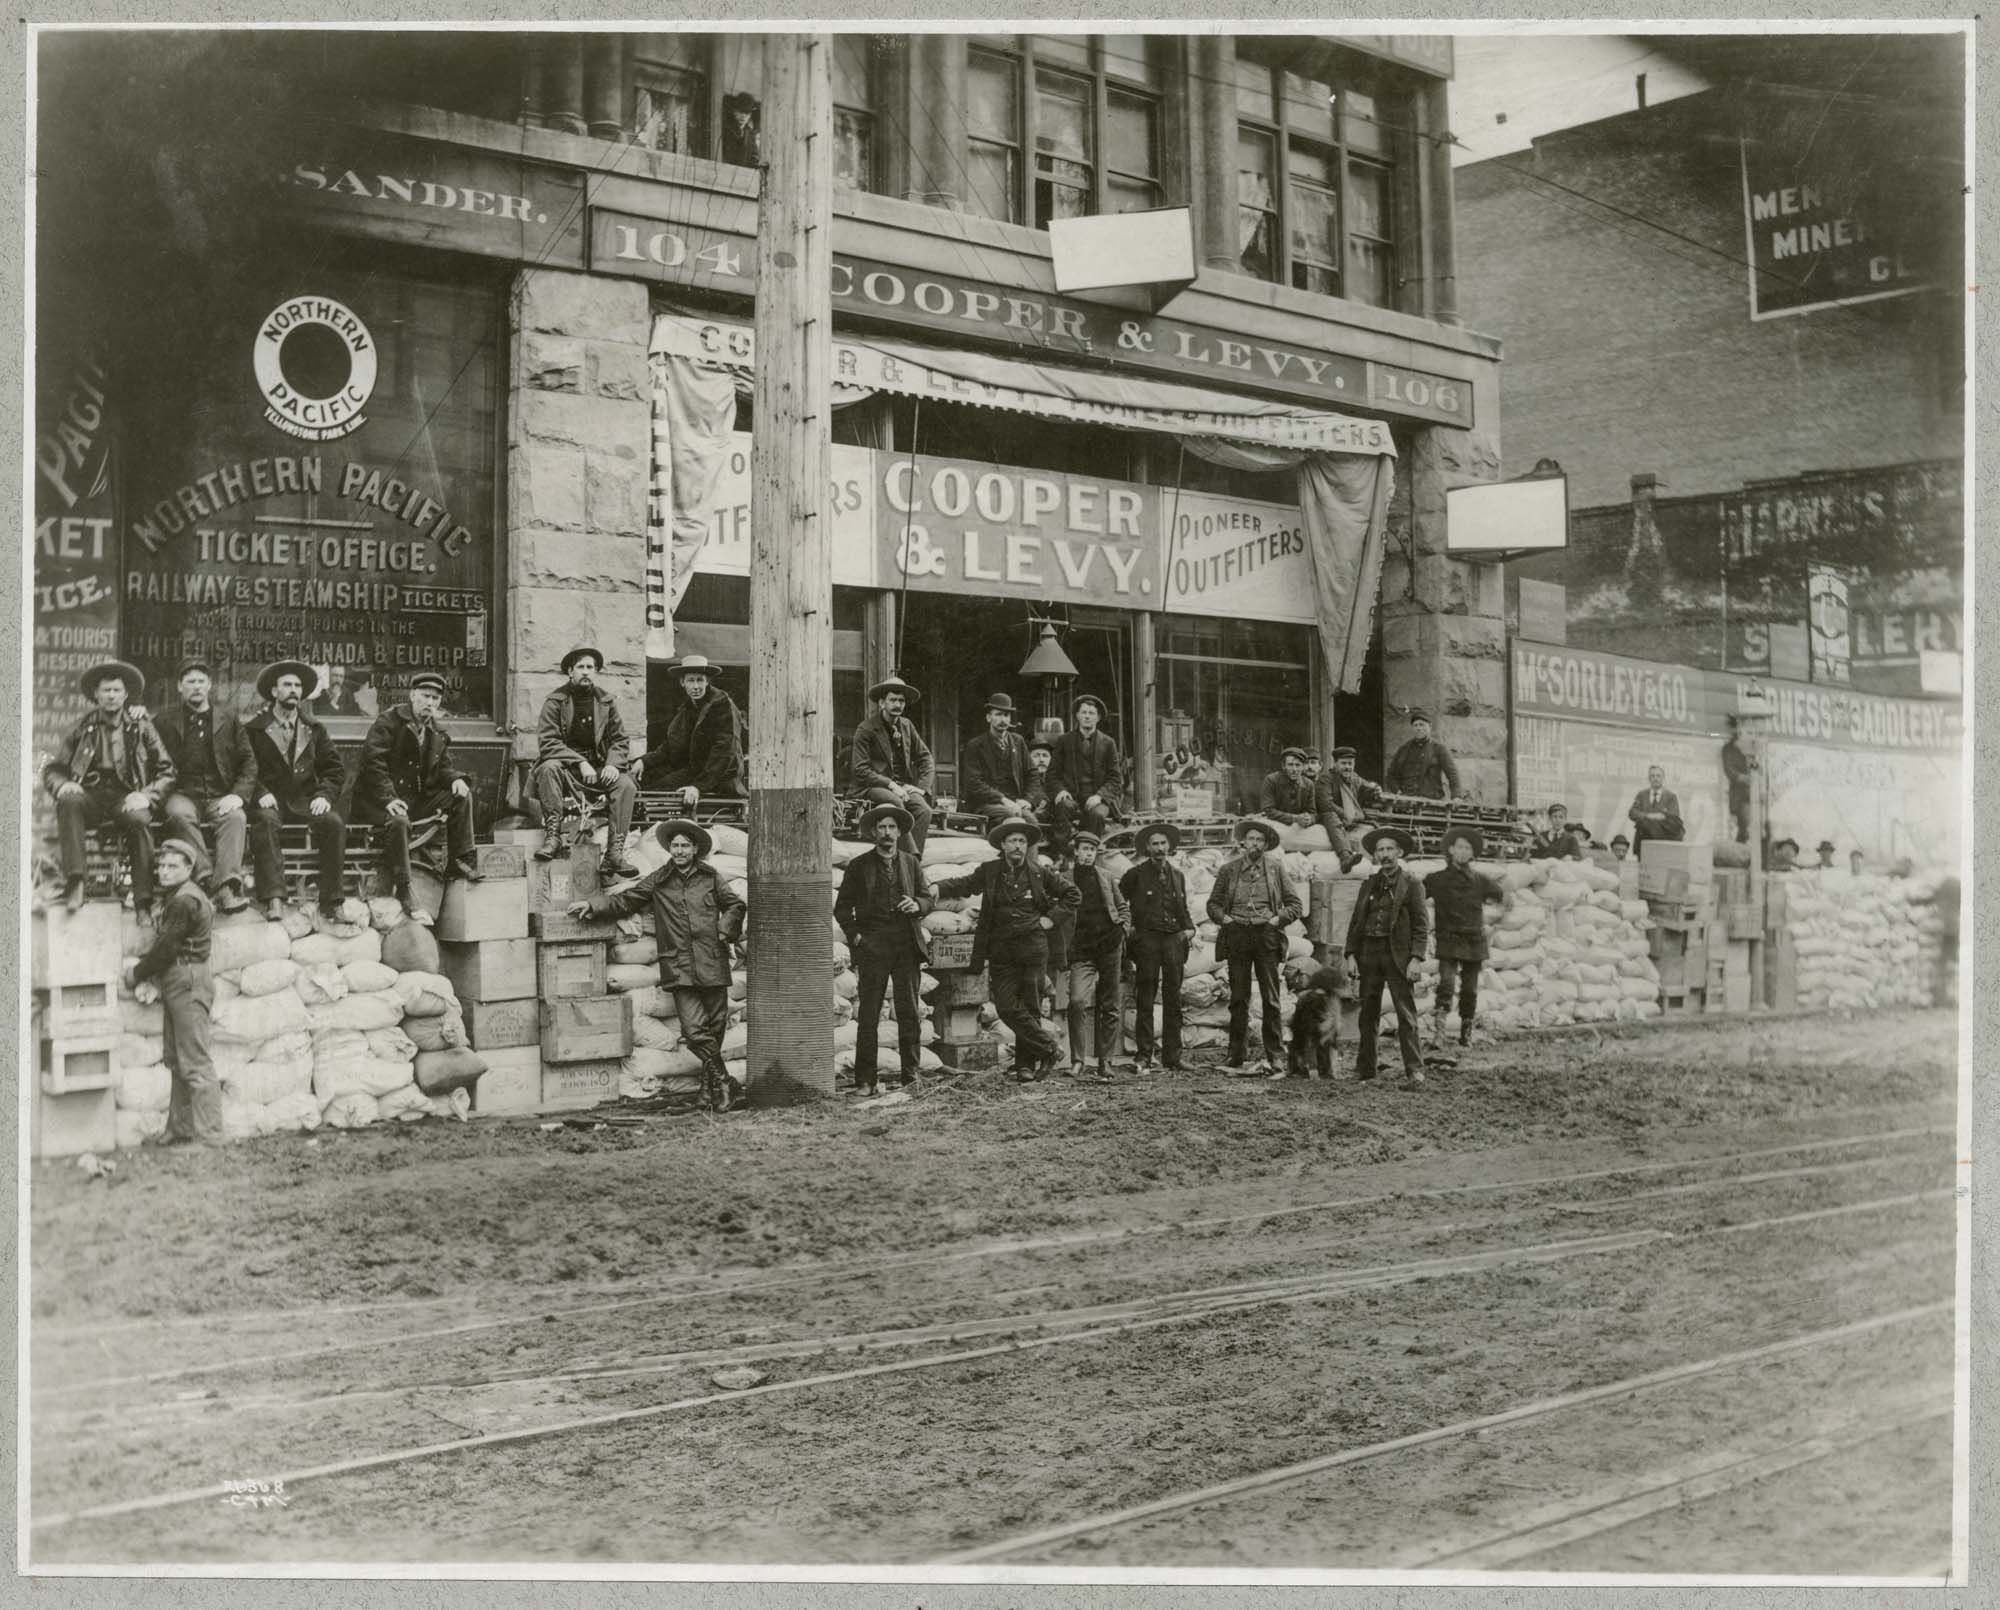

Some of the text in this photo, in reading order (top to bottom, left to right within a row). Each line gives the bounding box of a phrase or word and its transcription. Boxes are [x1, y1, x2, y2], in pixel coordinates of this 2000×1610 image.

[294, 163, 547, 224] SANDER.
[615, 225, 741, 277] 104
[263, 301, 368, 352] NORTHERN
[832, 263, 1345, 391] COOPER & LEVY.
[880, 355, 903, 384] &
[268, 382, 364, 423] PACIFIC
[1383, 373, 1460, 413] 106
[36, 362, 105, 508] PACI
[132, 456, 473, 558] NORTHERN PACIFIC
[884, 461, 1144, 537] COOPER
[1179, 511, 1262, 540] PIONEER
[197, 531, 438, 573] TICKET OFFICE.
[895, 524, 1153, 595] & LEVY.
[1175, 525, 1304, 597] OUTFITTERS
[34, 576, 112, 612] ICE.
[127, 571, 484, 611] RAILWAY & STEAMSHIP TICKETS
[51, 626, 118, 649] TOURIST
[392, 621, 416, 635] THE
[300, 642, 367, 664] CANADA
[375, 644, 386, 663] &
